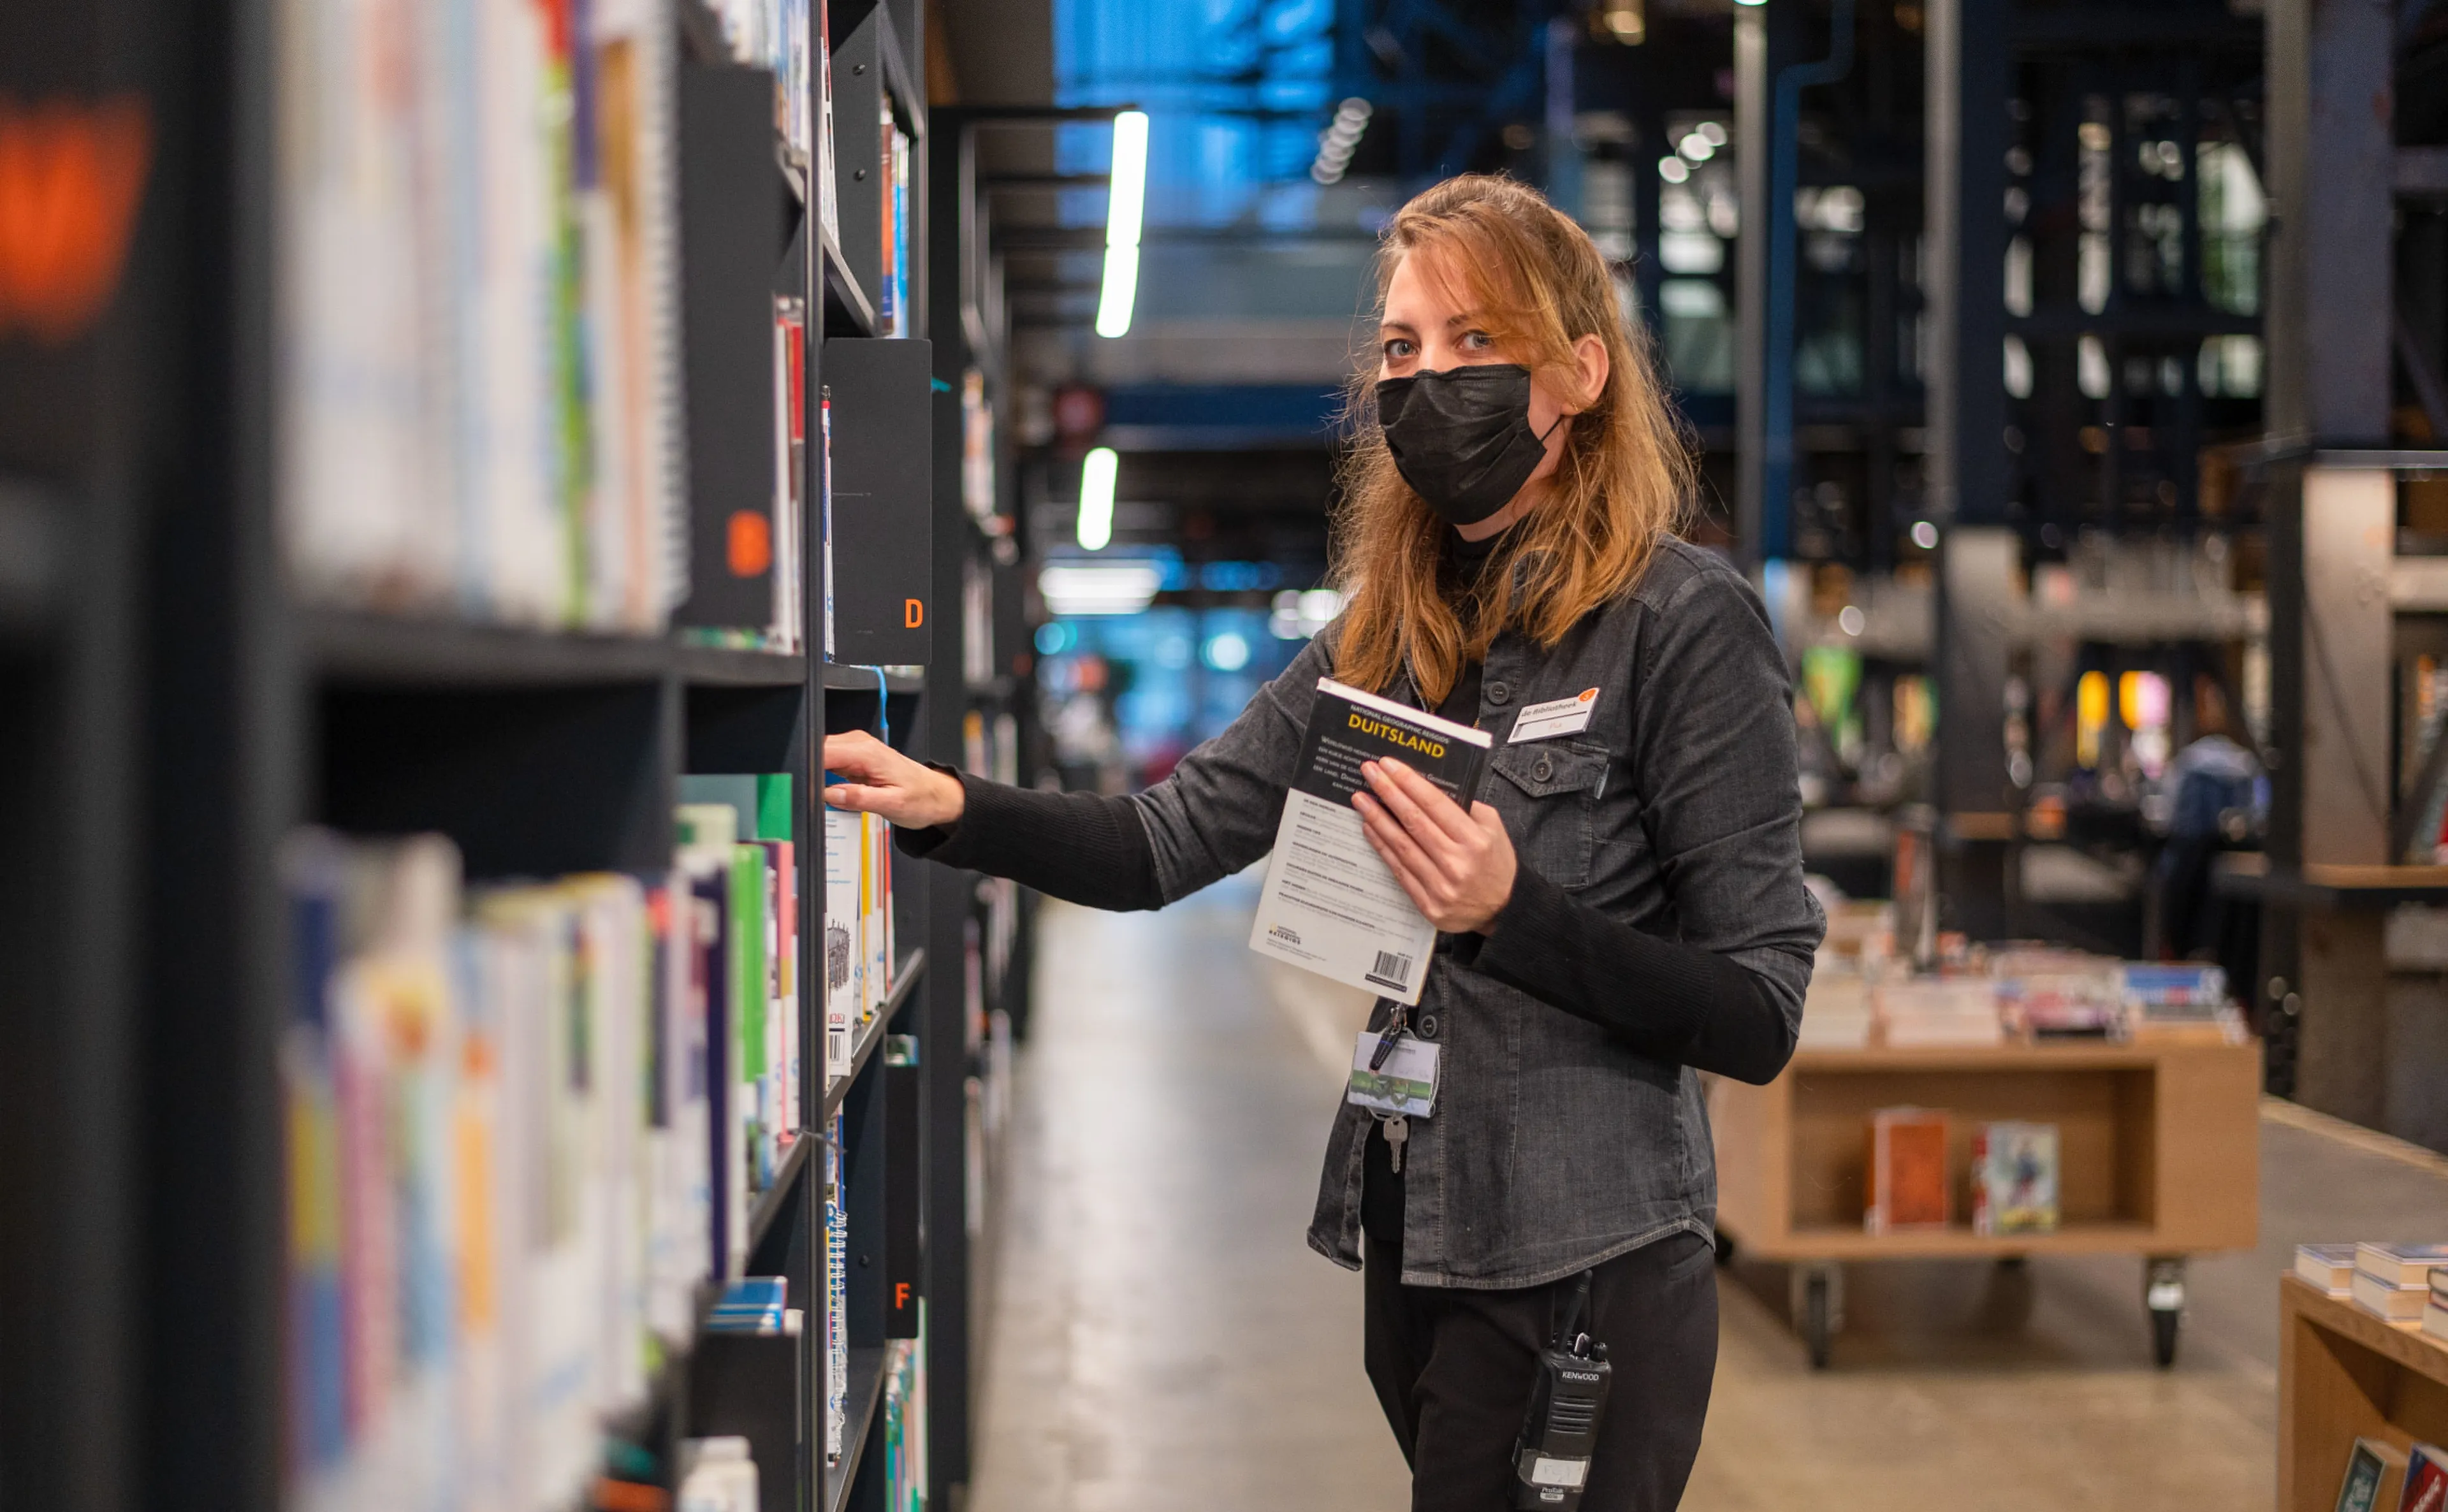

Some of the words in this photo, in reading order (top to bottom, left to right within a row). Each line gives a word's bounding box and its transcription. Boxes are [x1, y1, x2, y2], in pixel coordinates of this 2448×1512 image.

[905, 599, 923, 629] D
[1348, 714, 1445, 759] DUITSLAND
[896, 1283, 910, 1309] F
[1562, 1372, 1599, 1381] KENWOOD
